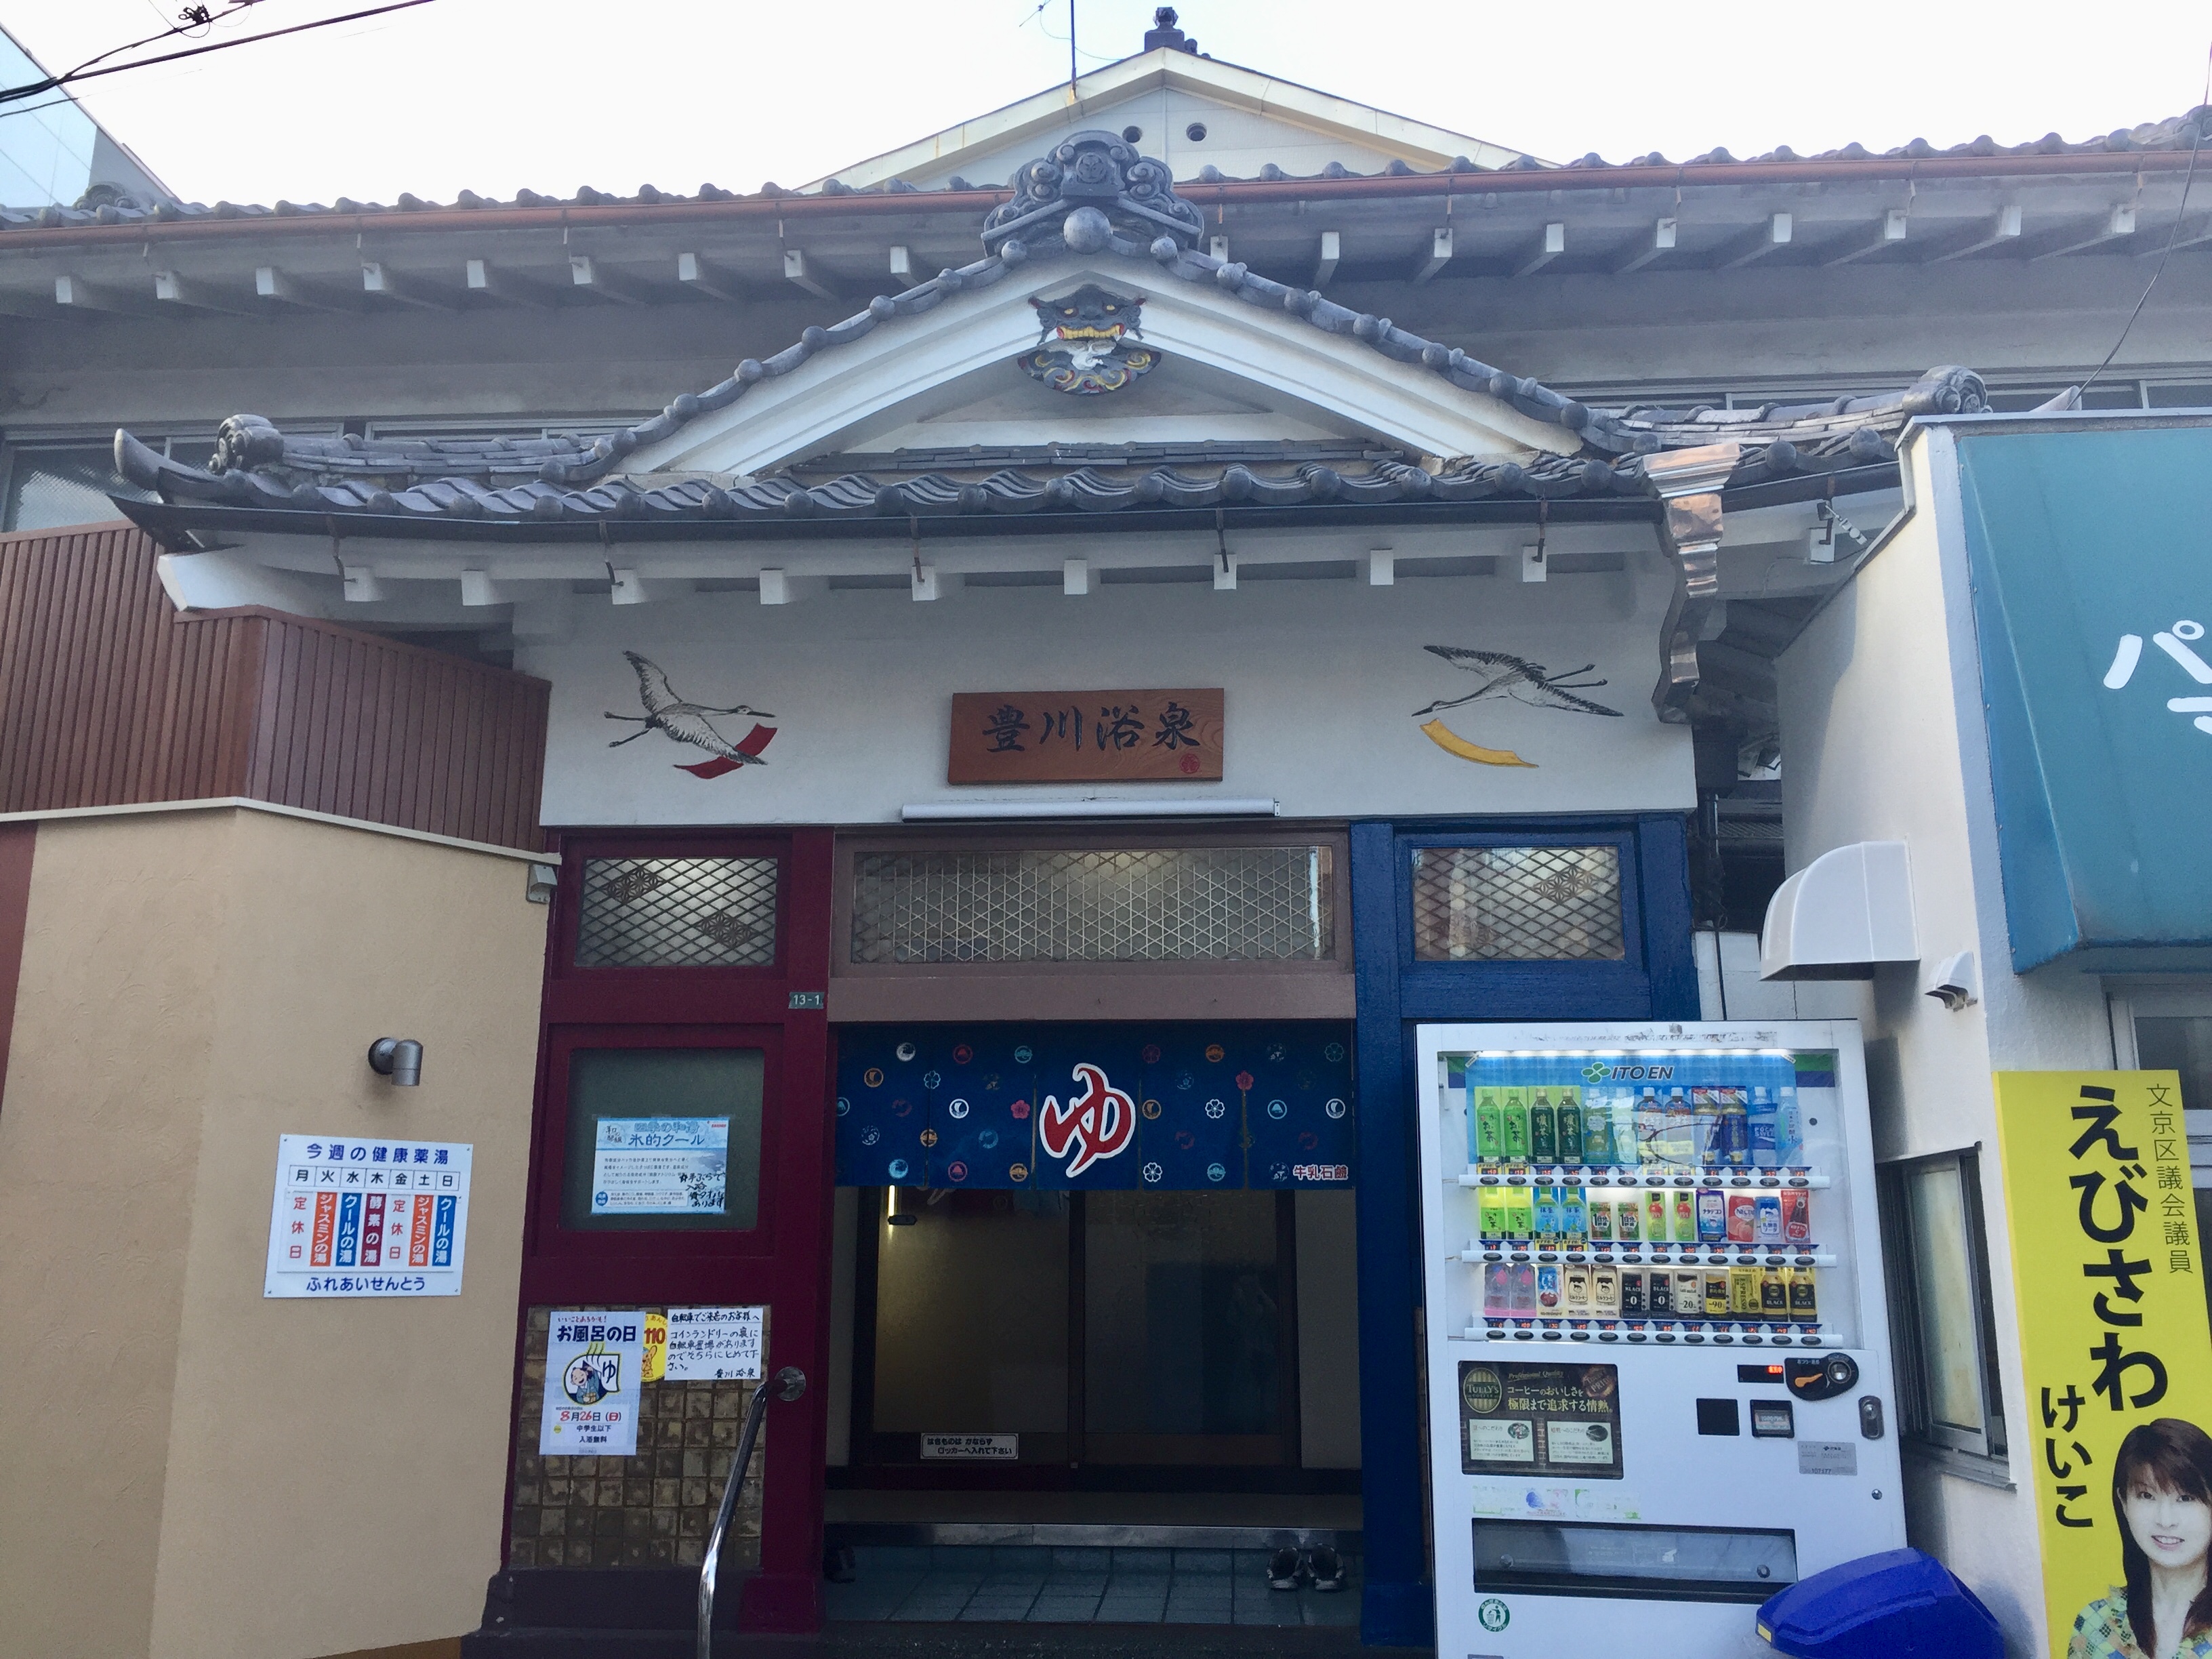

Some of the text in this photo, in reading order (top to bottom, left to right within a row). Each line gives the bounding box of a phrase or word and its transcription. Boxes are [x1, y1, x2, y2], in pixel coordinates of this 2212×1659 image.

[982, 701, 1201, 753] 豊川浴泉
[794, 994, 819, 1005] 13-1
[1611, 1065, 1674, 1080] ITO EN
[1039, 1063, 1136, 1178] ゆ
[628, 1134, 705, 1147] 氷的クール
[306, 1143, 449, 1165] 今週の健康薬湯
[295, 1170, 453, 1187] 月 火 水 木 金 土 日
[2146, 1084, 2194, 1275] 文京区議会議員
[289, 1196, 306, 1259] 定休日
[312, 1194, 335, 1263] ジャスミンの湯
[338, 1195, 359, 1263] クールの湯
[365, 1195, 384, 1263] 酵素の湯
[389, 1199, 406, 1260] 定休日
[411, 1197, 431, 1263] ジャスミンの湯
[434, 1197, 452, 1263] クールの湯
[2068, 1085, 2170, 1412] えびさわ
[306, 1277, 426, 1292] ふれあいせんとう
[557, 1325, 636, 1342] お風呂の日
[670, 1326, 758, 1339] コインランドリーの裏に
[668, 1350, 760, 1361] のでそちらにとめて下
[670, 1338, 755, 1351] 自転車置場があります
[602, 1360, 616, 1384] ゆ
[1508, 1386, 1584, 1397] コーヒーのおいしさを
[1508, 1397, 1613, 1413] 極限まで追求する情熱。
[579, 1435, 607, 1443] 入浴無料
[2041, 1384, 2095, 1528] けいこ
